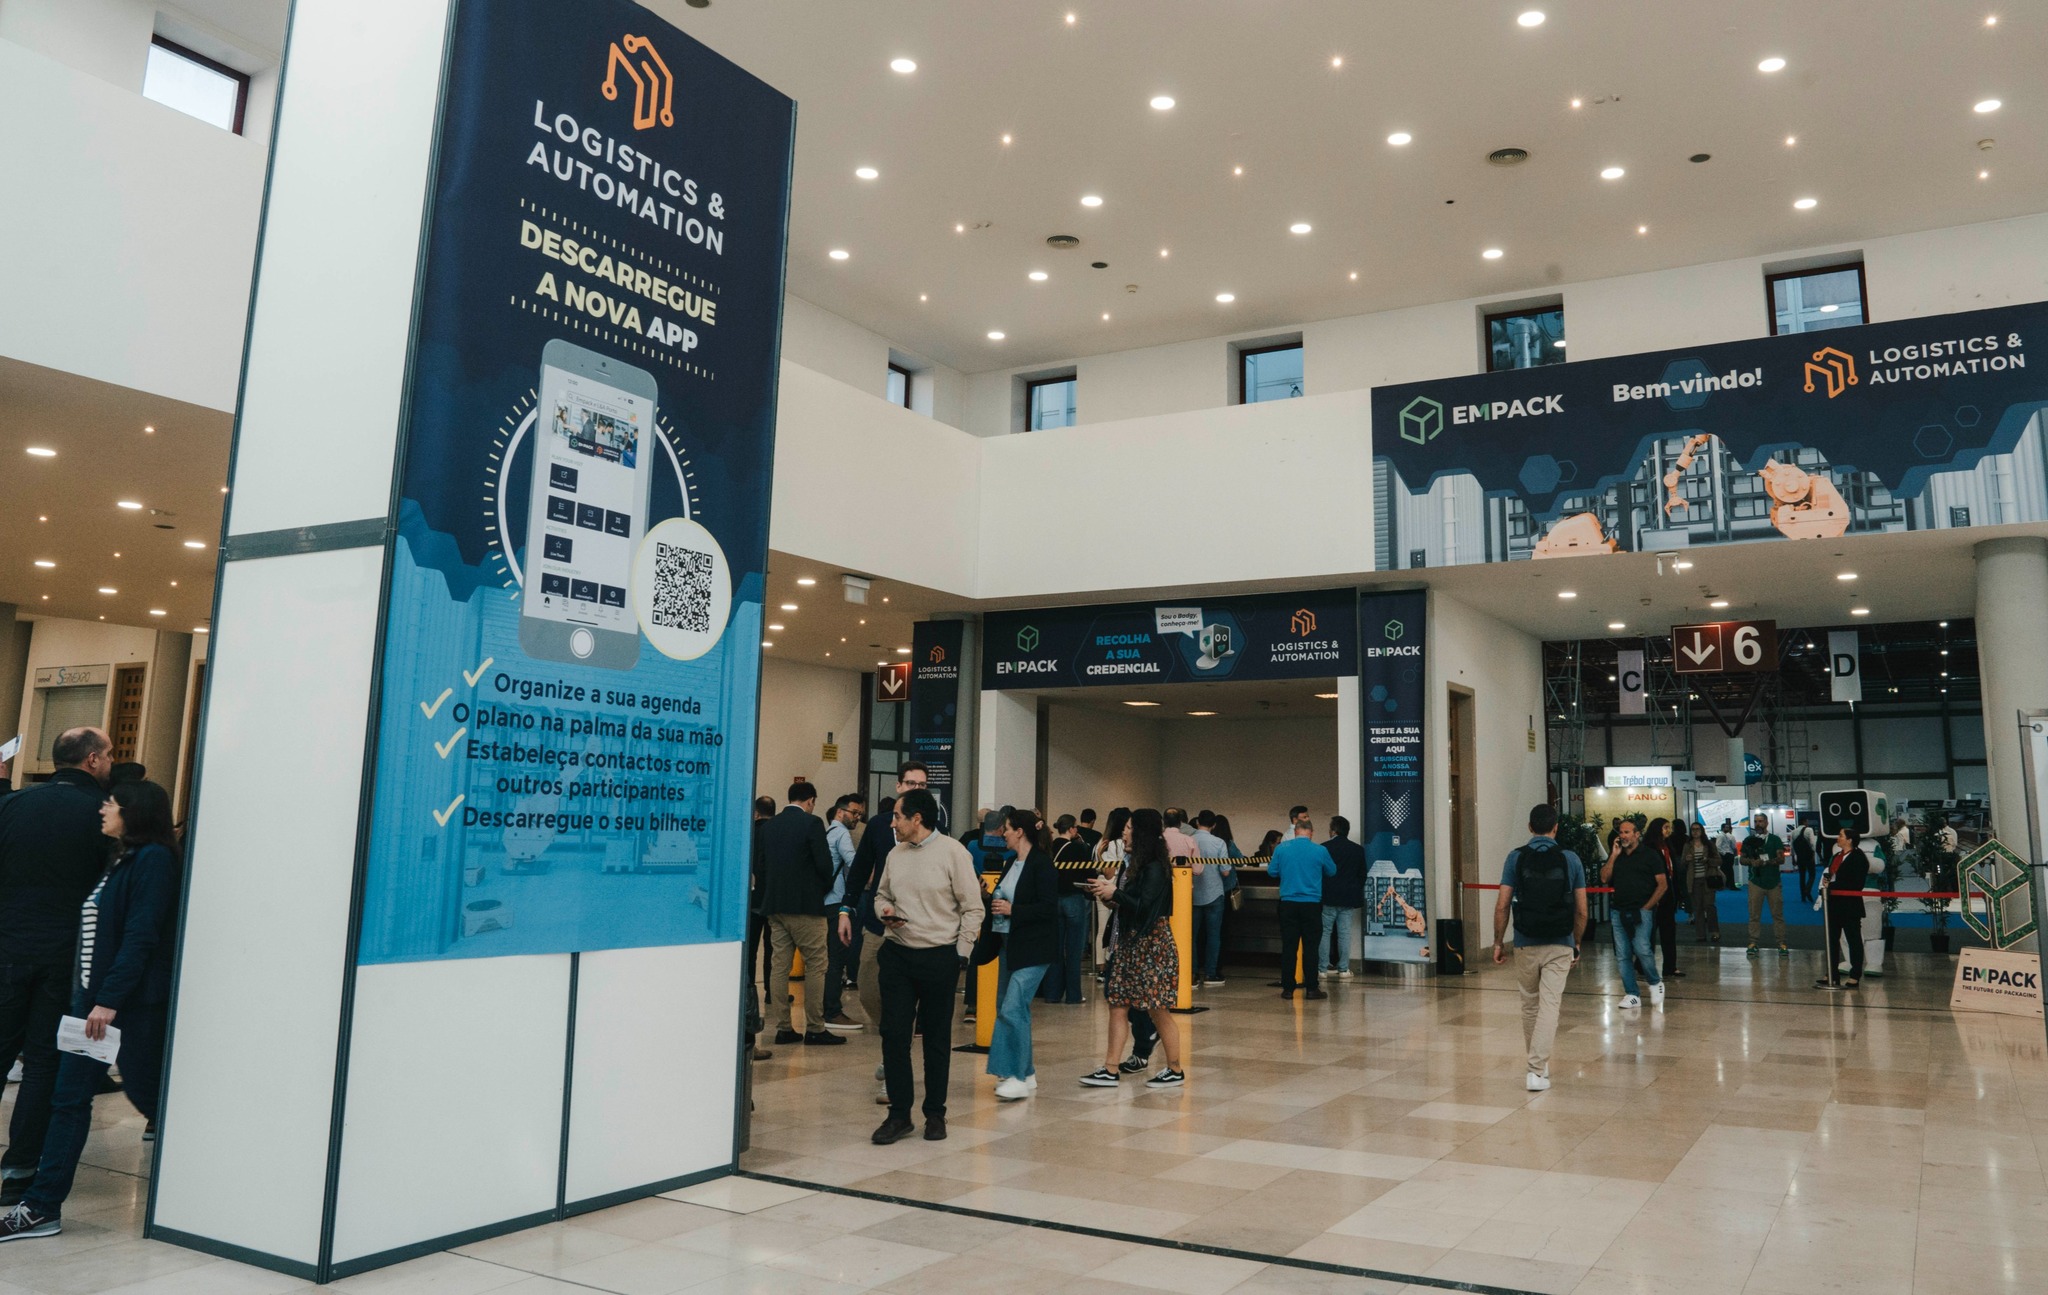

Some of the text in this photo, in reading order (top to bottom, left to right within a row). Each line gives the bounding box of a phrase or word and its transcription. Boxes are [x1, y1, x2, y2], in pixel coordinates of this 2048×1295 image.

[534, 100, 725, 220] LOGISTICS &
[526, 142, 724, 256] AUTOMATION
[520, 220, 717, 326] DESCARREGUE
[536, 272, 698, 353] A NOVA APP
[1870, 333, 2023, 365] LOGISTICS &
[1869, 353, 2026, 385] AUTOMATION
[1453, 367, 1763, 425] EMPACK Bem-vindo!
[1096, 634, 1151, 645] RECOLHA
[1271, 640, 1339, 652] LOGISTICS &
[1367, 645, 1421, 658] EMPACK
[1733, 626, 1762, 665] 6
[996, 659, 1058, 675] EMPACK
[1106, 649, 1141, 660] A SUA
[1271, 651, 1339, 663] AUTOMATION
[1834, 653, 1856, 677] D
[1087, 662, 1160, 675] CREDENCIAL
[495, 673, 701, 715] Organize a sua agenda
[1622, 671, 1641, 692] C
[452, 703, 724, 747] O plano na palma da sua mão
[466, 739, 710, 775] Estabeleça contactos com
[496, 776, 684, 801] outros participantes
[1623, 776, 1668, 786] Trébol group
[463, 806, 706, 833] Descarregue o seu bilhete
[1962, 966, 2037, 989] EMPACK
[2004, 990, 2037, 998] PACKAGING
